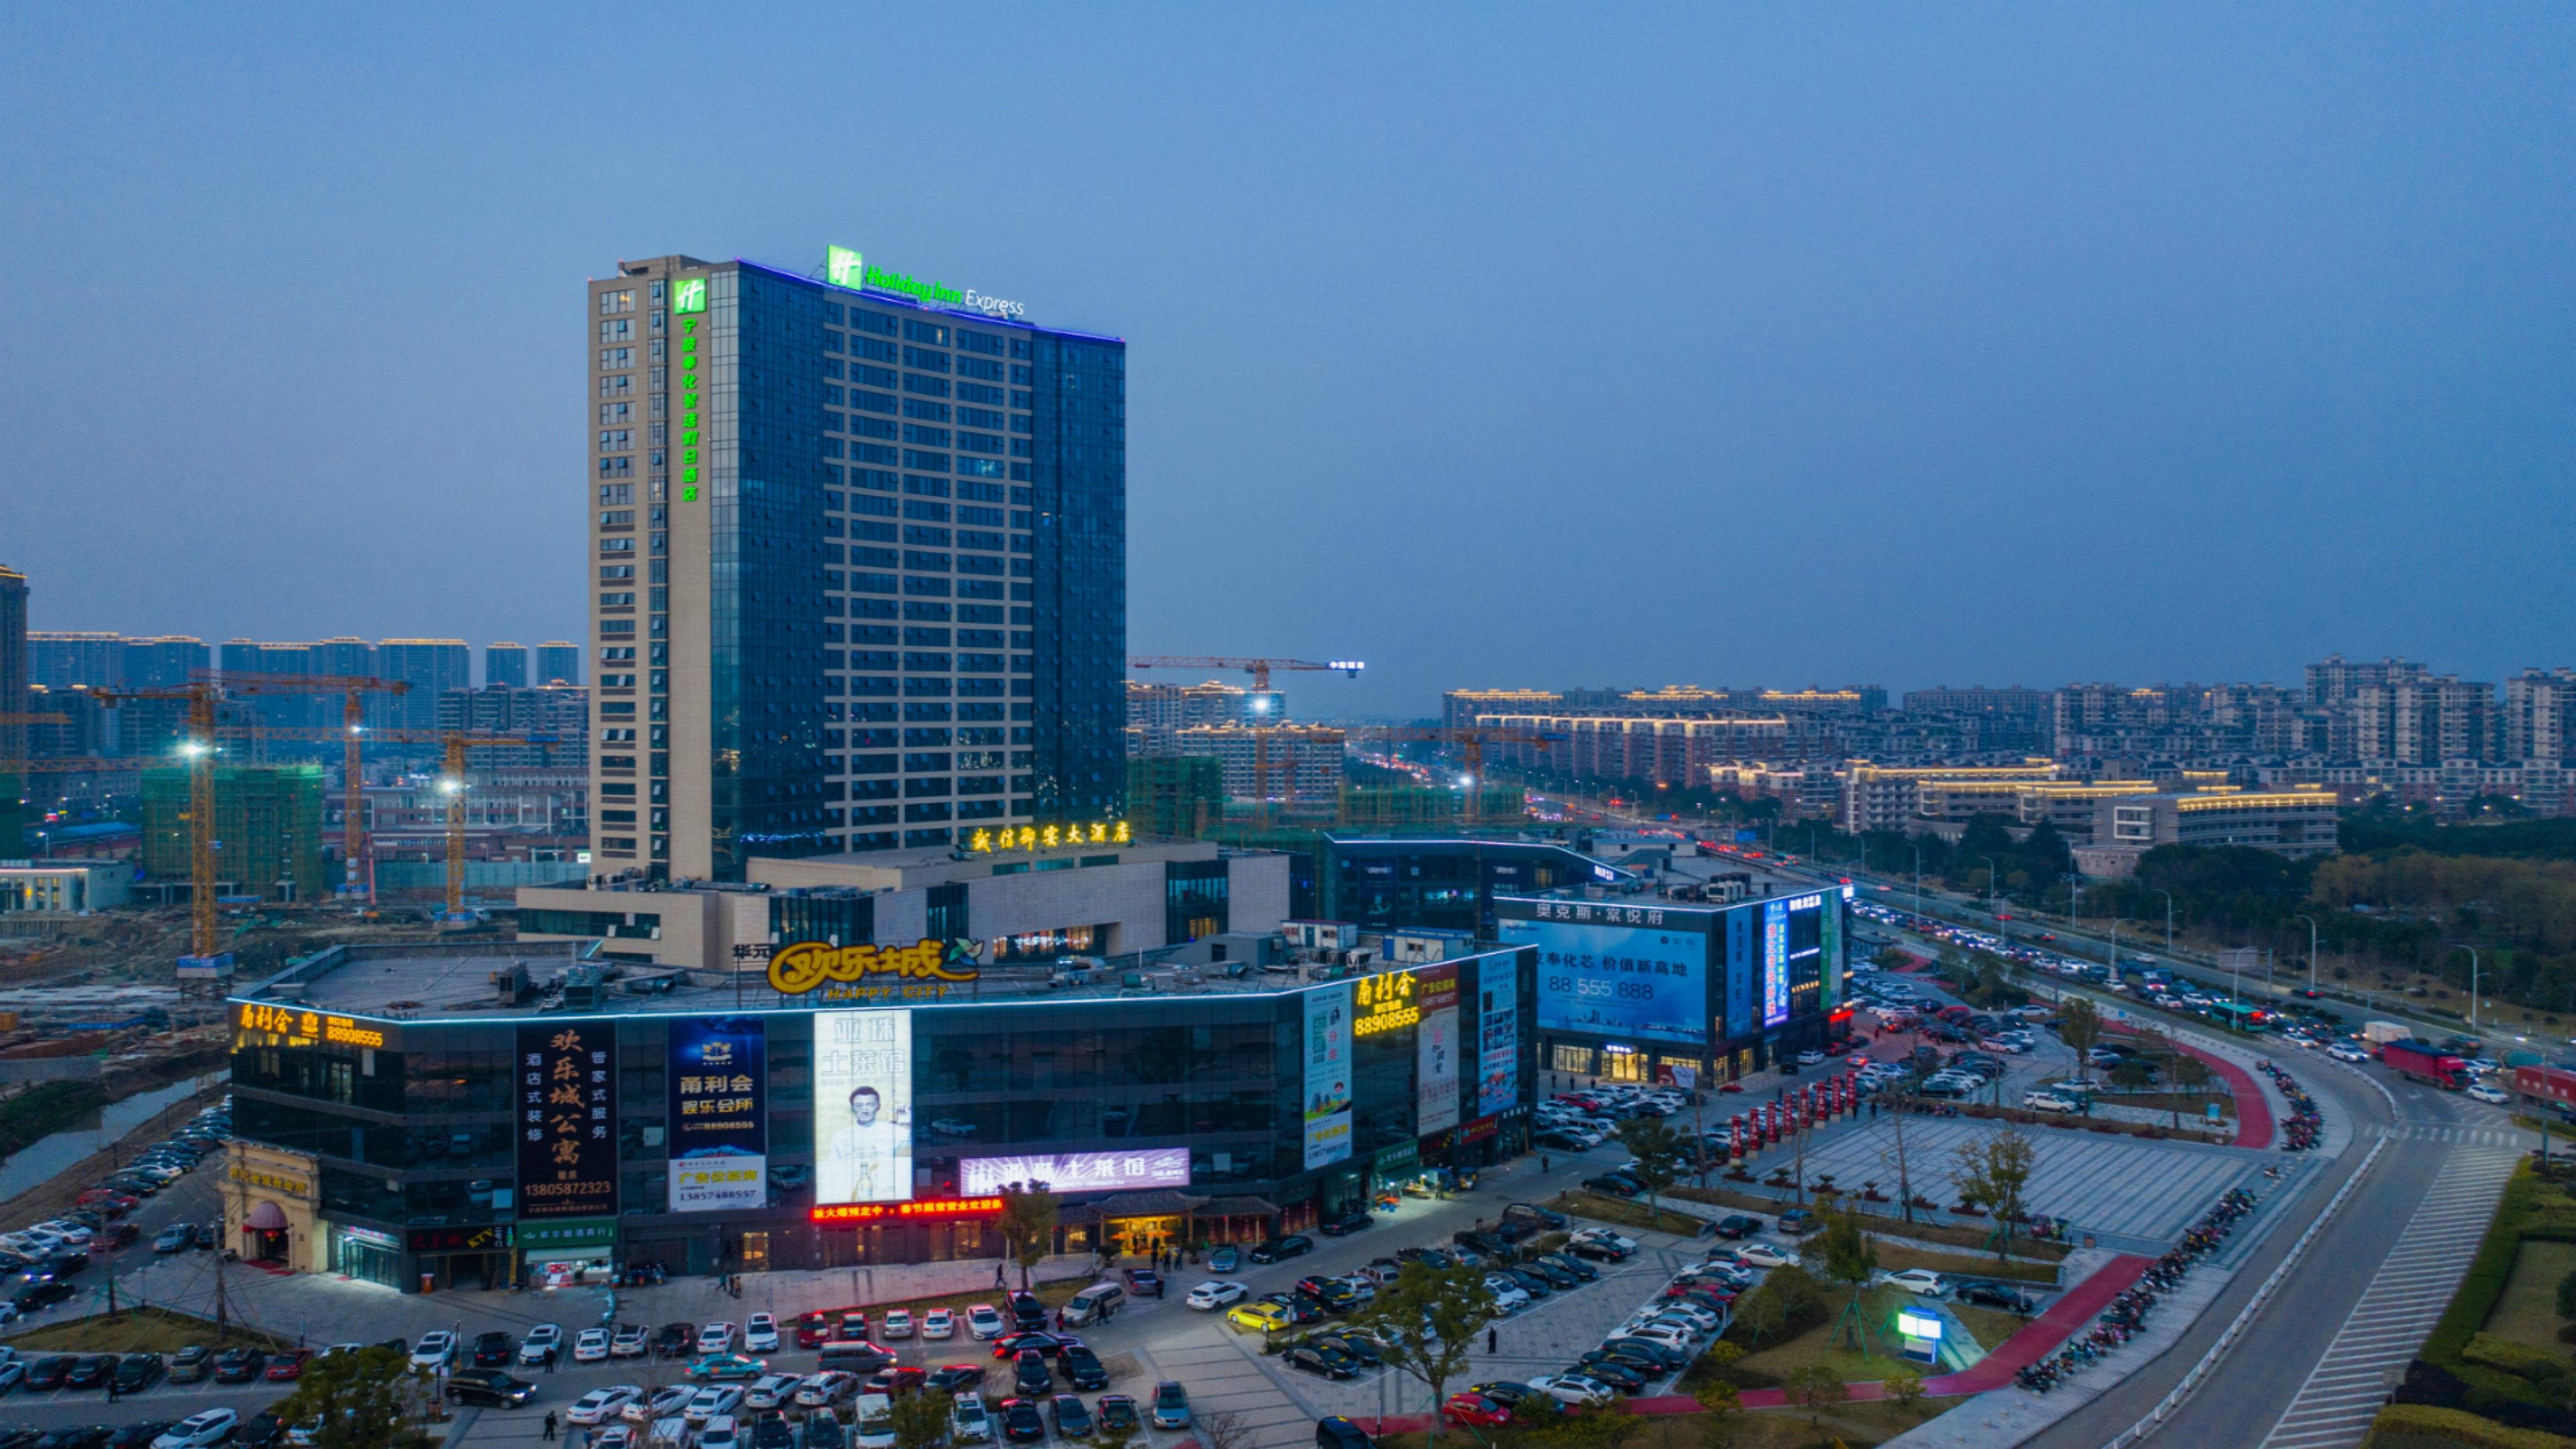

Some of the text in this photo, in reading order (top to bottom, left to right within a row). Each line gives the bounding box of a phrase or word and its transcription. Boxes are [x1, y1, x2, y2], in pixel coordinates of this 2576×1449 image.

[866, 265, 1025, 316] Holiday Inn Express
[767, 938, 979, 995] 欢乐城
[1602, 955, 1688, 977] 价值新高地
[827, 985, 949, 1000] HAPPY CITY
[1549, 975, 1654, 1000] 88 555 888
[1354, 1006, 1419, 1036] 88908555
[326, 1026, 383, 1048] 88908555
[821, 1048, 906, 1076] 土菜馆
[549, 1029, 586, 1165] 欢乐城公寓
[591, 1051, 607, 1139] 管家式服务
[681, 1098, 753, 1116] 娱乐会所
[525, 1181, 611, 1197] 13805872323
[468, 1227, 494, 1248] KTV
